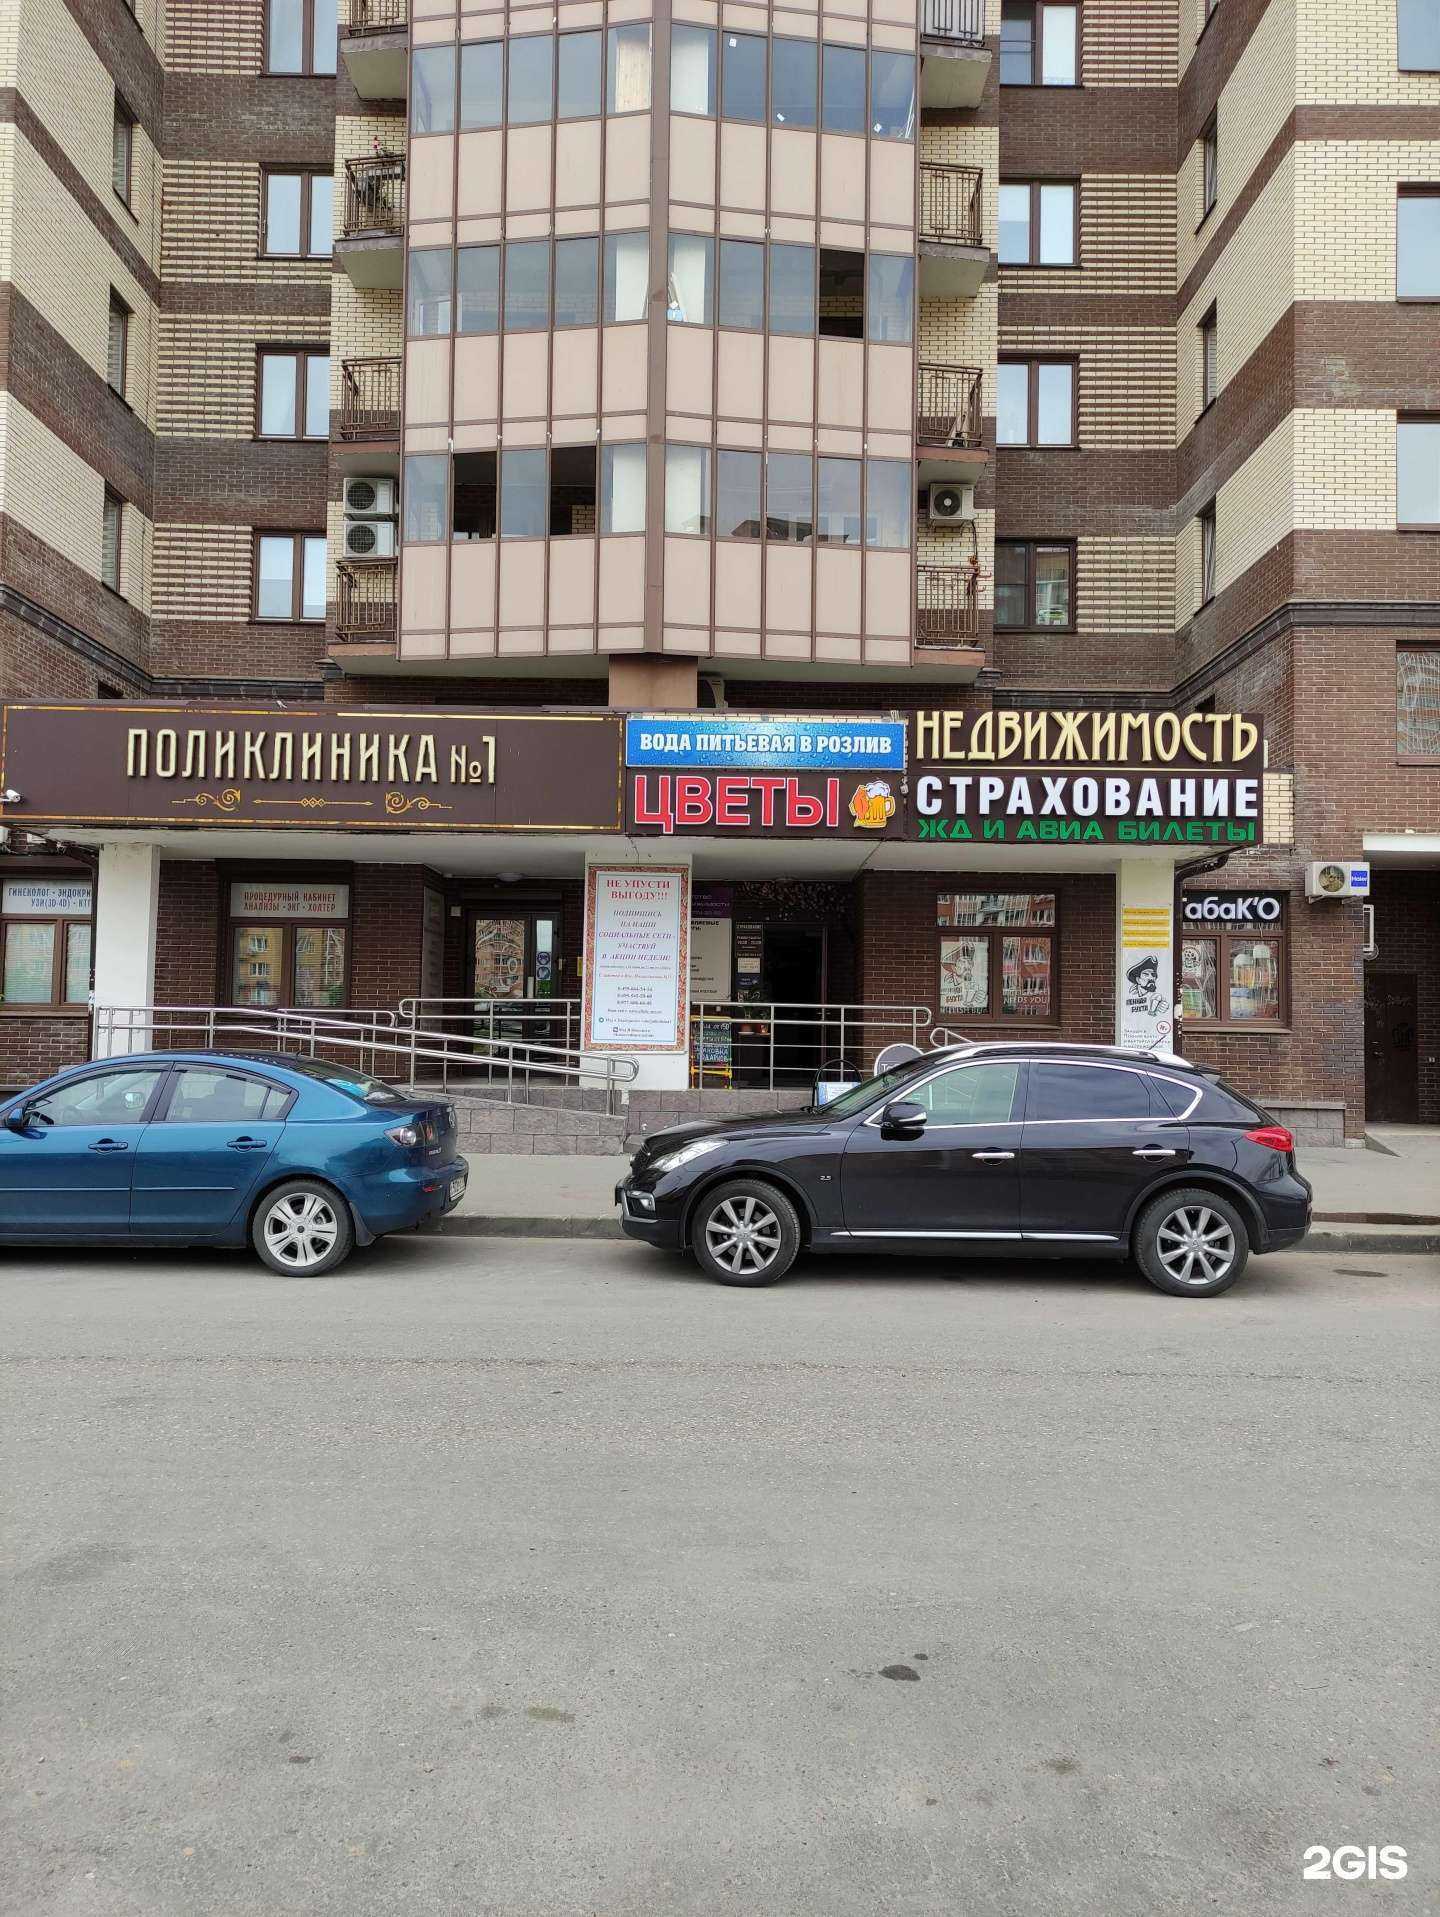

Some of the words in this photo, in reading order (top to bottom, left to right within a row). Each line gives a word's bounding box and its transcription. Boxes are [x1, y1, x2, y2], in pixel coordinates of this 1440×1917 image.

[640, 733, 692, 752] ВОДА
[696, 734, 799, 753] ПИТЬЕВАЯ
[800, 736, 814, 752] В
[816, 736, 892, 754] РОЗЛИВ
[916, 710, 1258, 763] НЕДВИЖИМОСТЬ
[127, 728, 439, 784] ПОЛИКЛИНИКА
[450, 735, 496, 785] №1
[634, 774, 840, 834] ЦВЕТЫ
[916, 775, 1258, 817] СТРАХОВАНИЕ
[918, 819, 973, 840] ЖД
[983, 819, 1006, 840] И
[1016, 819, 1105, 841] АВИА
[1118, 820, 1256, 842] БИЛЕТЫ
[8, 887, 50, 898] ГИНЕКОЛОГ
[606, 879, 621, 888] НЕ
[625, 880, 670, 889] УПУСТИ
[244, 891, 299, 903] ПРОЦЕДУРНЫЙ
[303, 892, 337, 902] КАБИНЕТ
[611, 890, 668, 901] ВЫГОДУ!!!
[243, 903, 280, 912] АНАЛИЗЫ
[287, 903, 301, 912] ЭКГ
[307, 903, 336, 913] ХОЛТЕР
